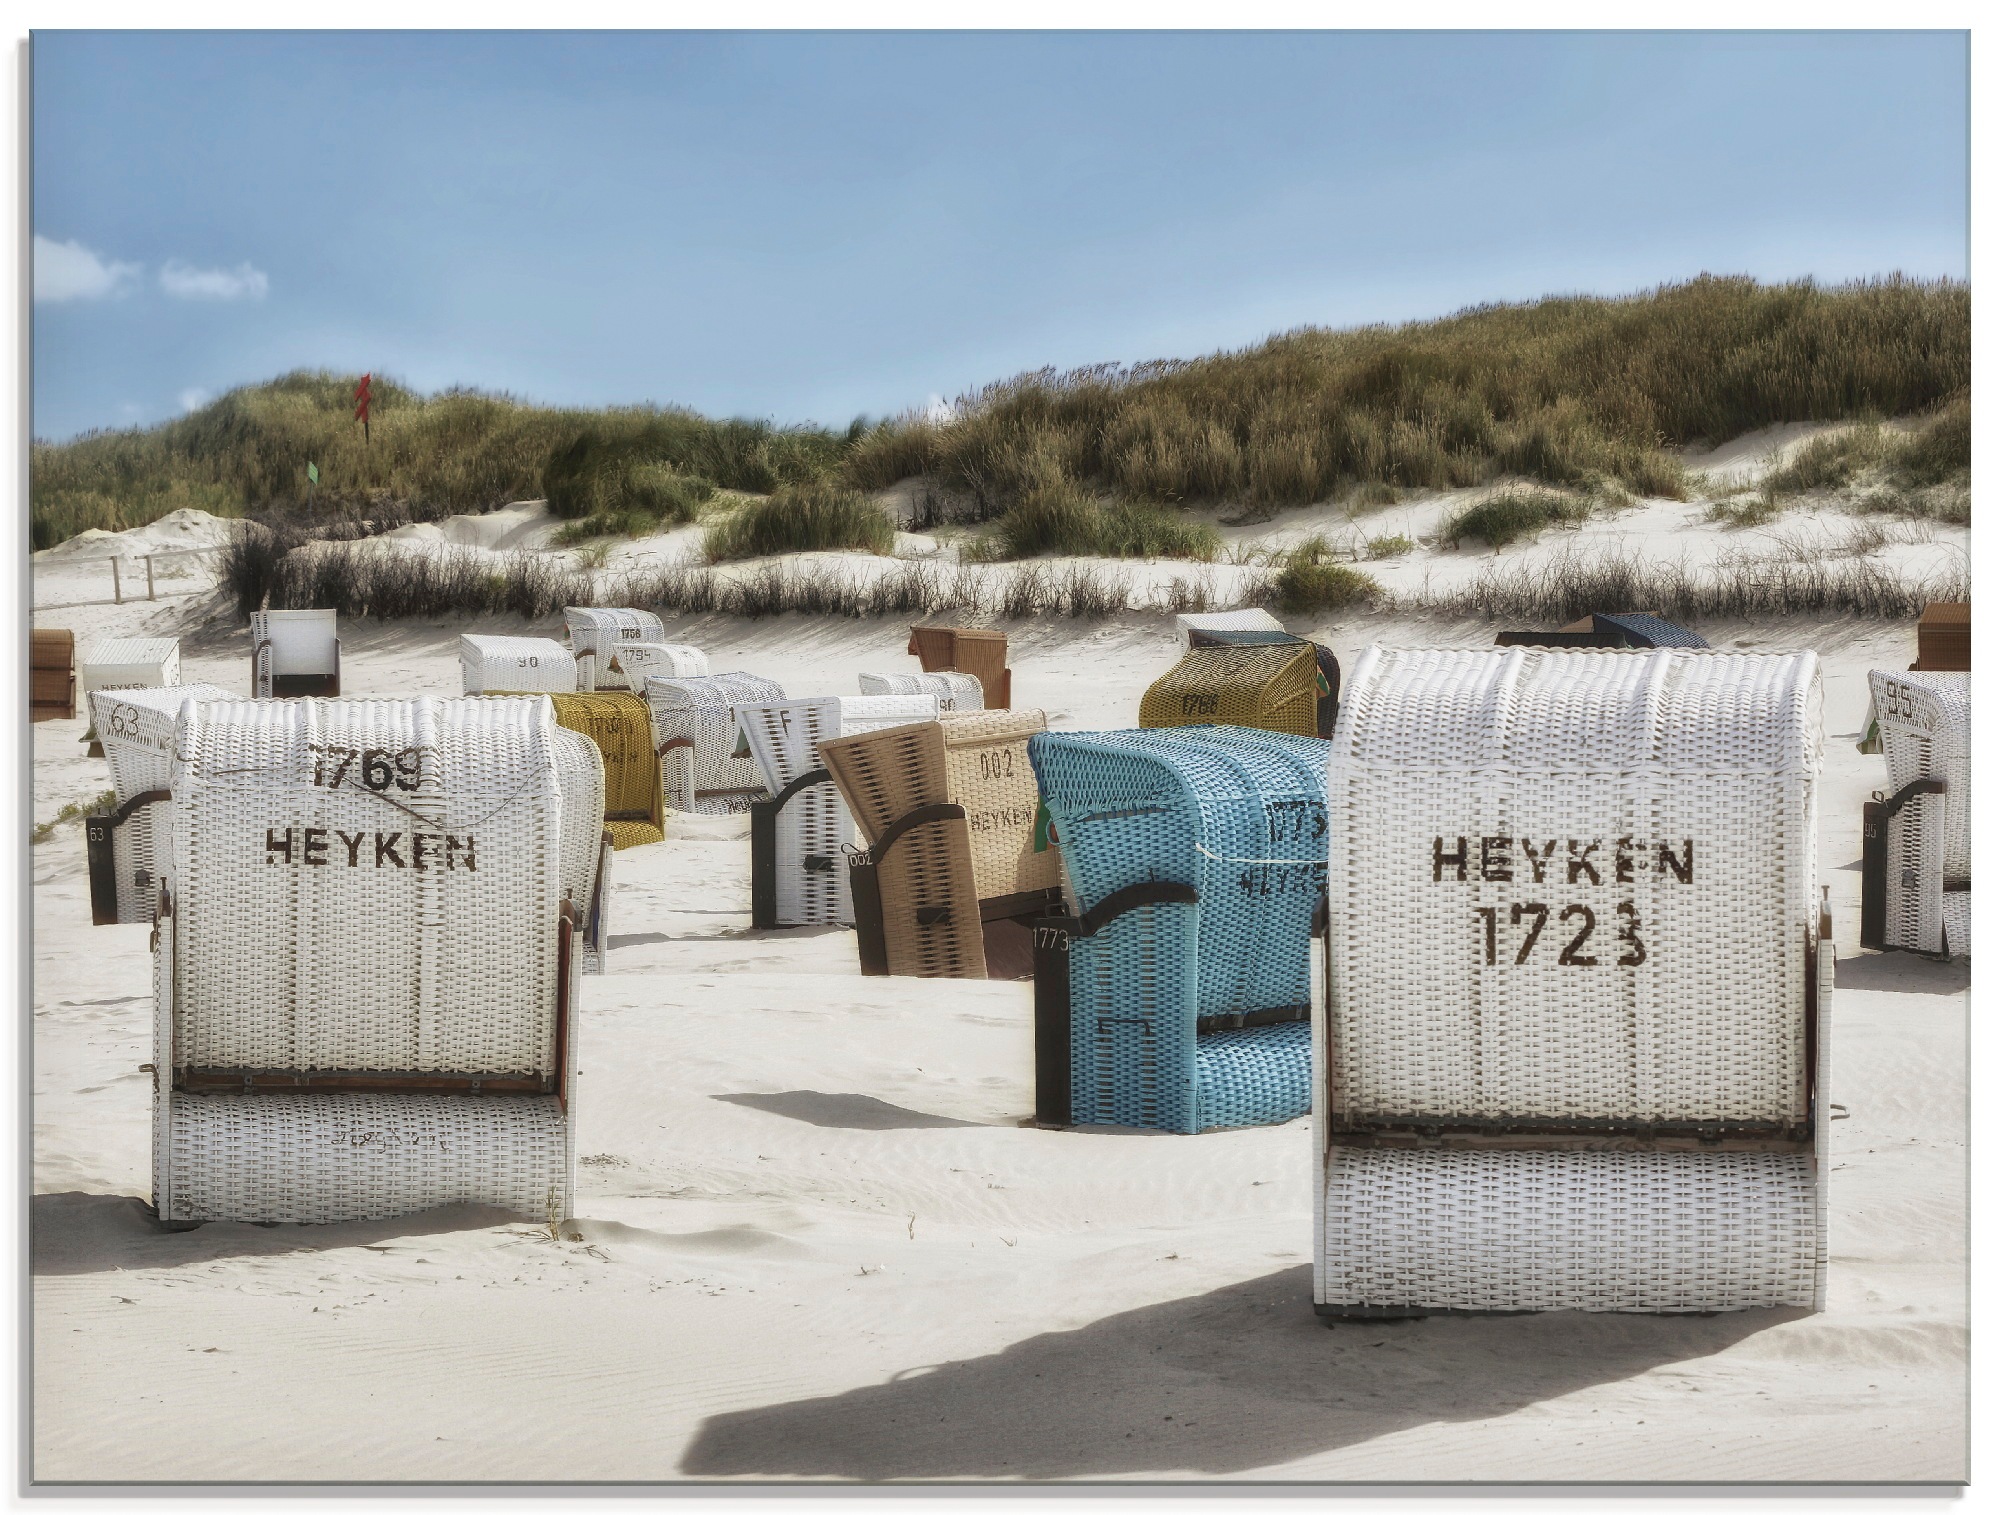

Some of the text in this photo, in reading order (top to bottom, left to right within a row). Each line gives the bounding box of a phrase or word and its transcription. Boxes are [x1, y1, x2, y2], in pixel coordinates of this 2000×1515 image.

[1886, 680, 1913, 719] 95
[111, 703, 139, 736] 63
[308, 743, 424, 792] 1769
[980, 749, 1014, 781] 002
[89, 827, 104, 842] 63
[971, 806, 1033, 831] HEYKEN
[1864, 822, 1877, 839] 95
[265, 827, 477, 872] HEYKEN
[849, 853, 873, 867] 002
[1432, 835, 1695, 885] HEYKEN
[1032, 927, 1069, 951] 1773
[1474, 900, 1648, 966] 1723
